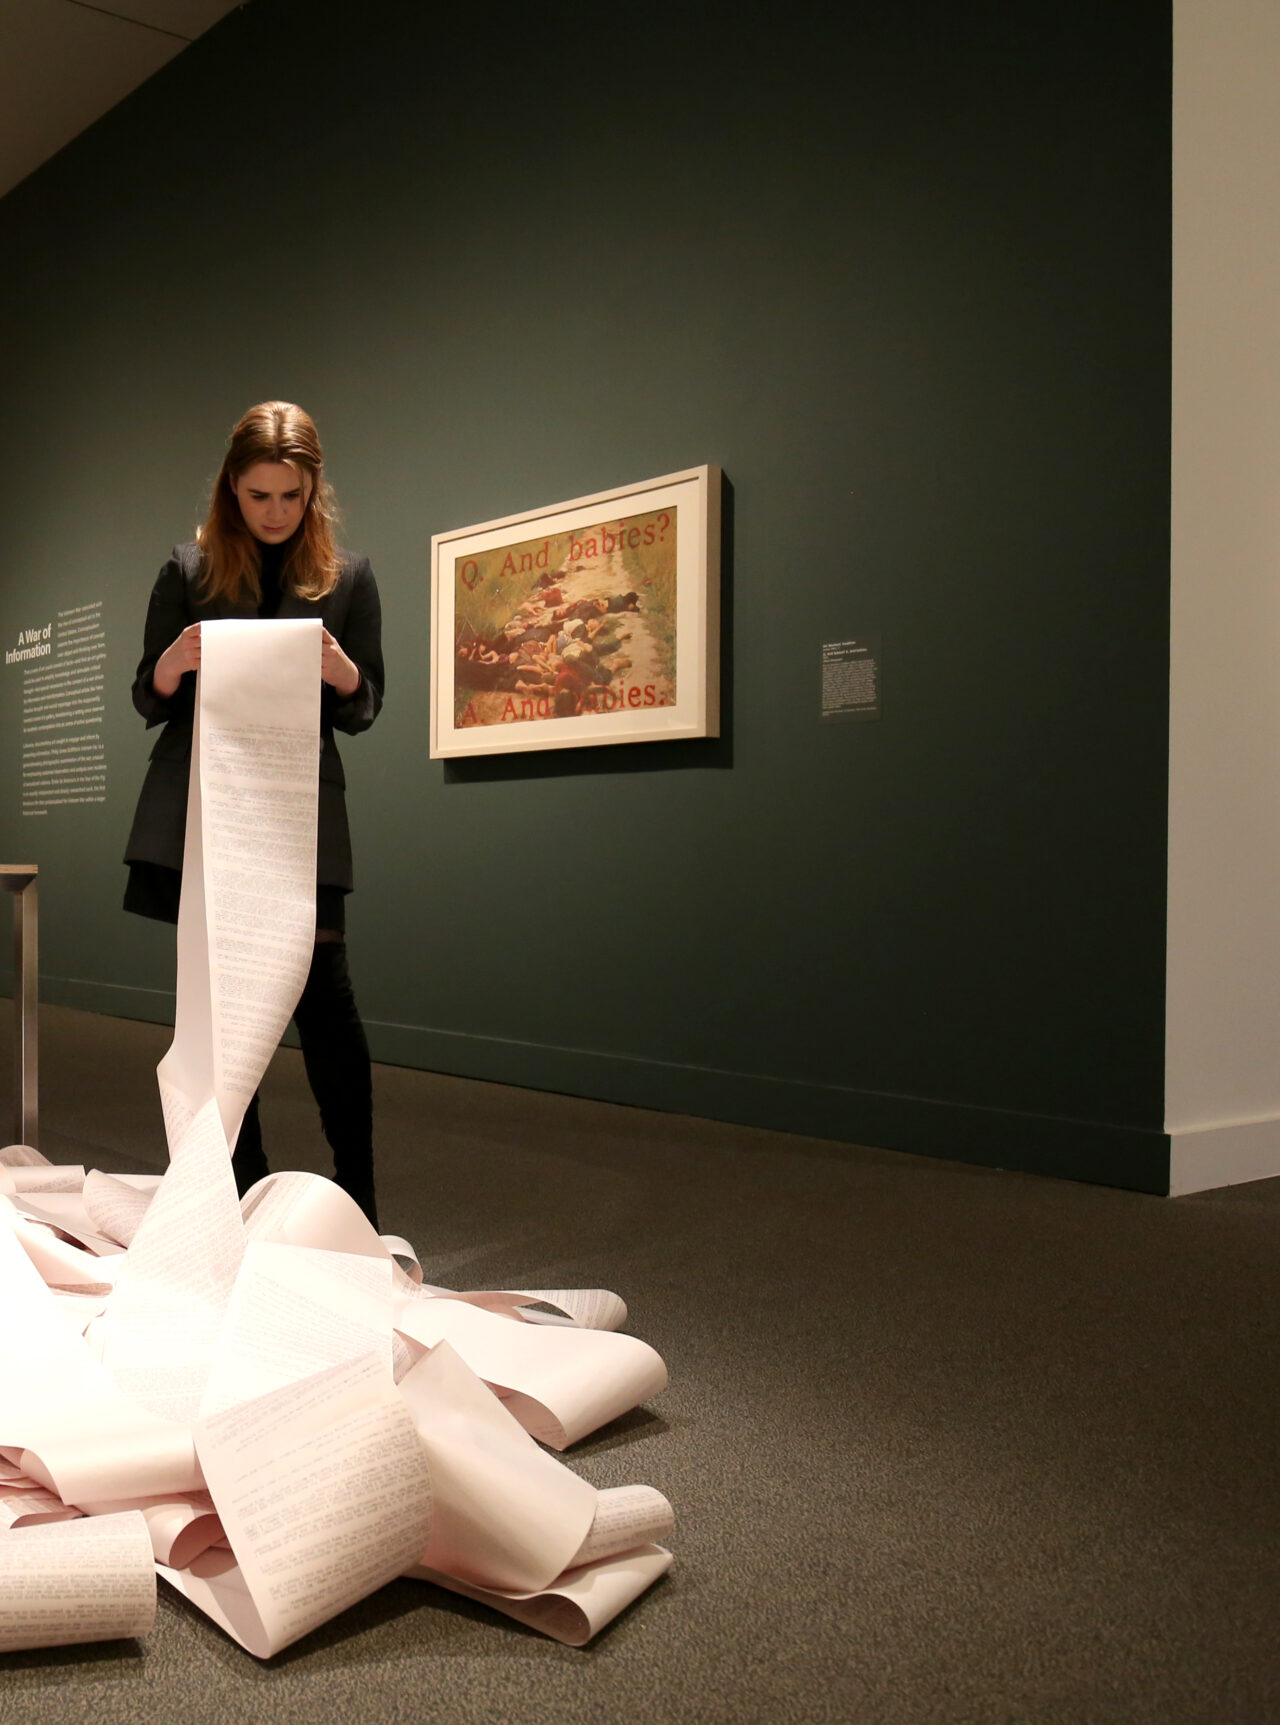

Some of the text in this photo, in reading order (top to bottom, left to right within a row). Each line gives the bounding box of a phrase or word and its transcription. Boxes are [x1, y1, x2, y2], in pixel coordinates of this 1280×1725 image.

[461, 513, 670, 591] Q. And babies?
[18, 623, 52, 646] A War of
[5, 642, 51, 664] Information
[463, 702, 484, 725] A.
[501, 695, 551, 721] And
